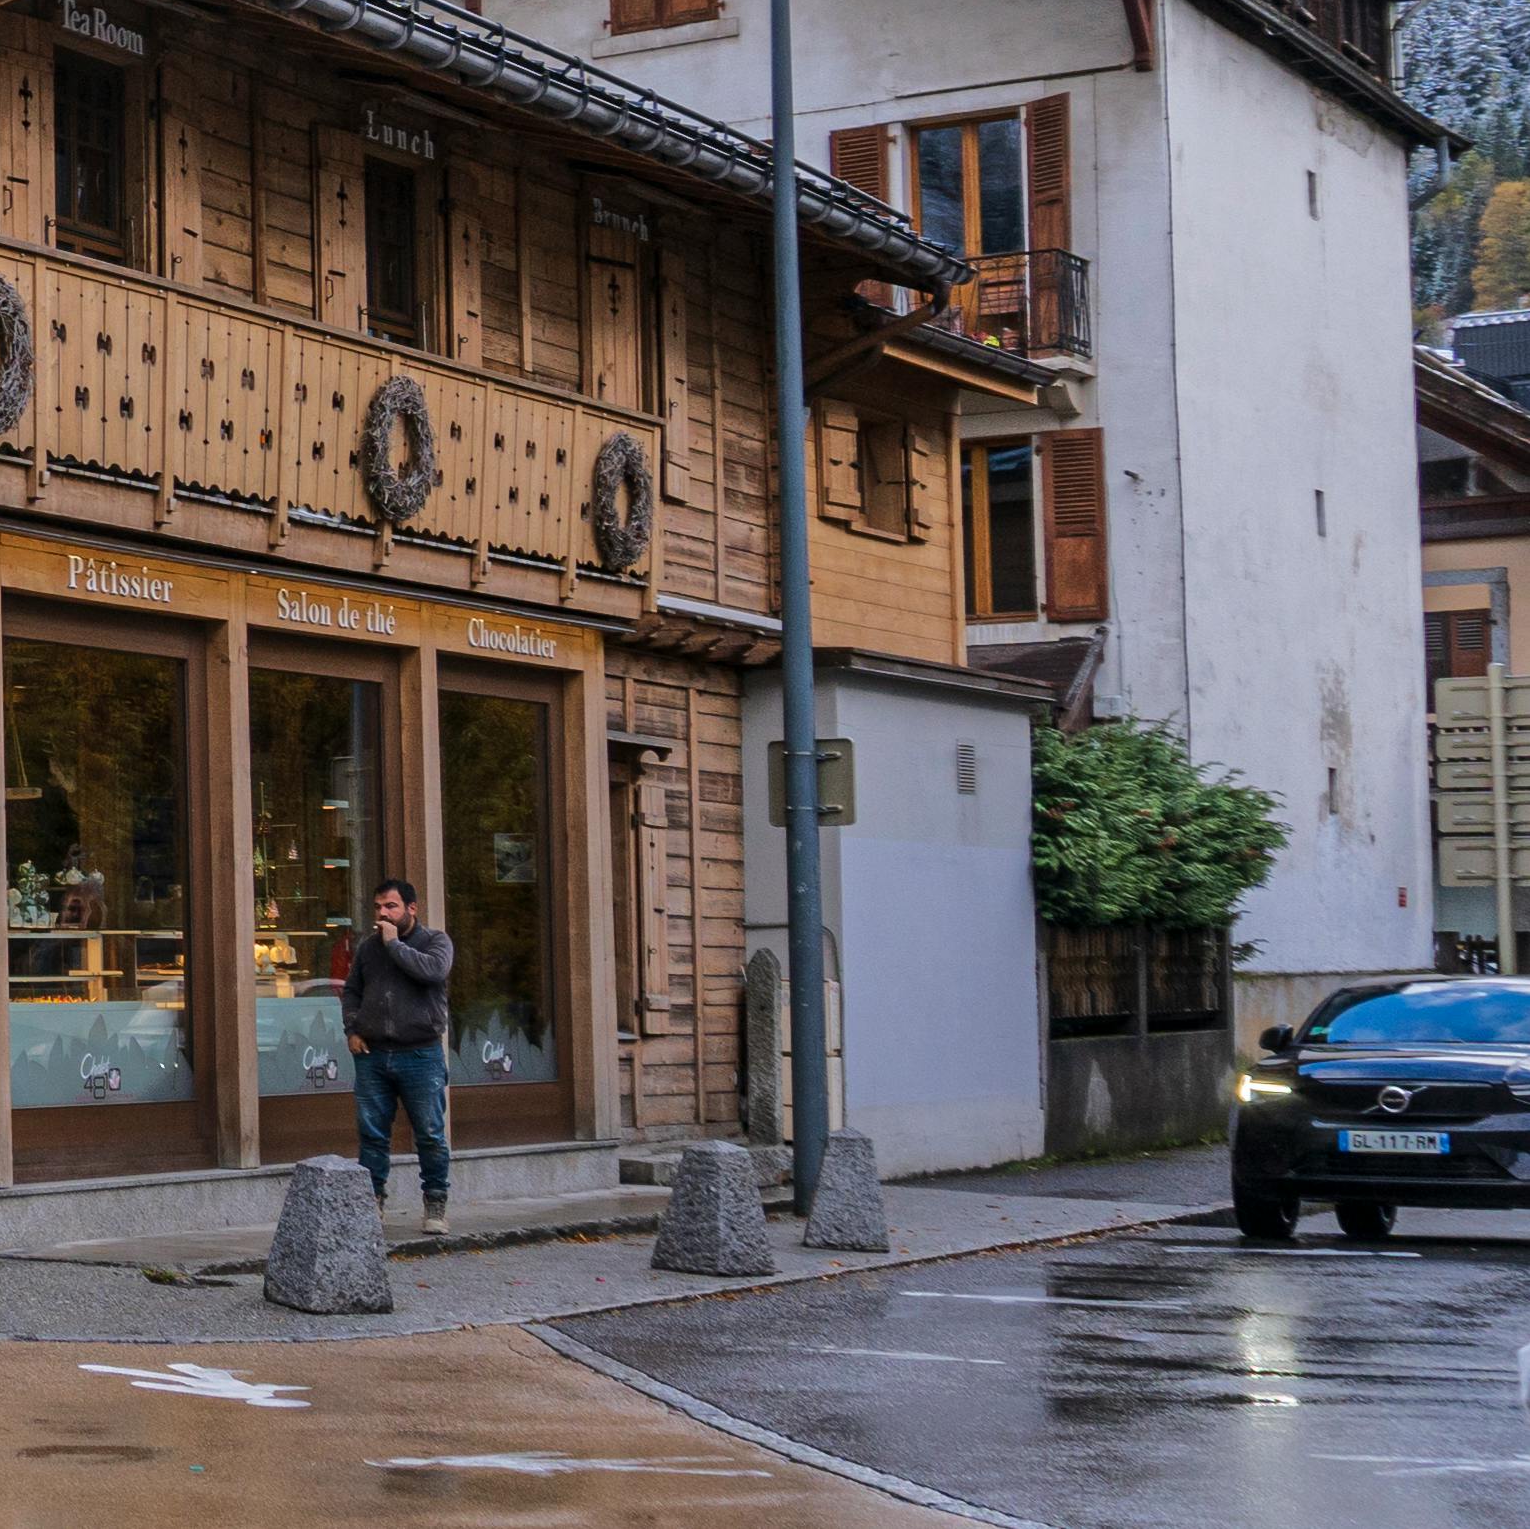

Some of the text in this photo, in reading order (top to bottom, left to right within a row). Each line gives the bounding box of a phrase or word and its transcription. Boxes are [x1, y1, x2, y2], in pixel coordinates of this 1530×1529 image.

[93, 7, 144, 55] Room
[366, 110, 435, 160] Lunch
[593, 197, 649, 241] Brunch
[68, 554, 173, 603] Pâtissier
[277, 588, 396, 635] Salon de thé
[468, 618, 557, 659] Chocolatier
[1351, 1134, 1439, 1150] GL-117-RM
